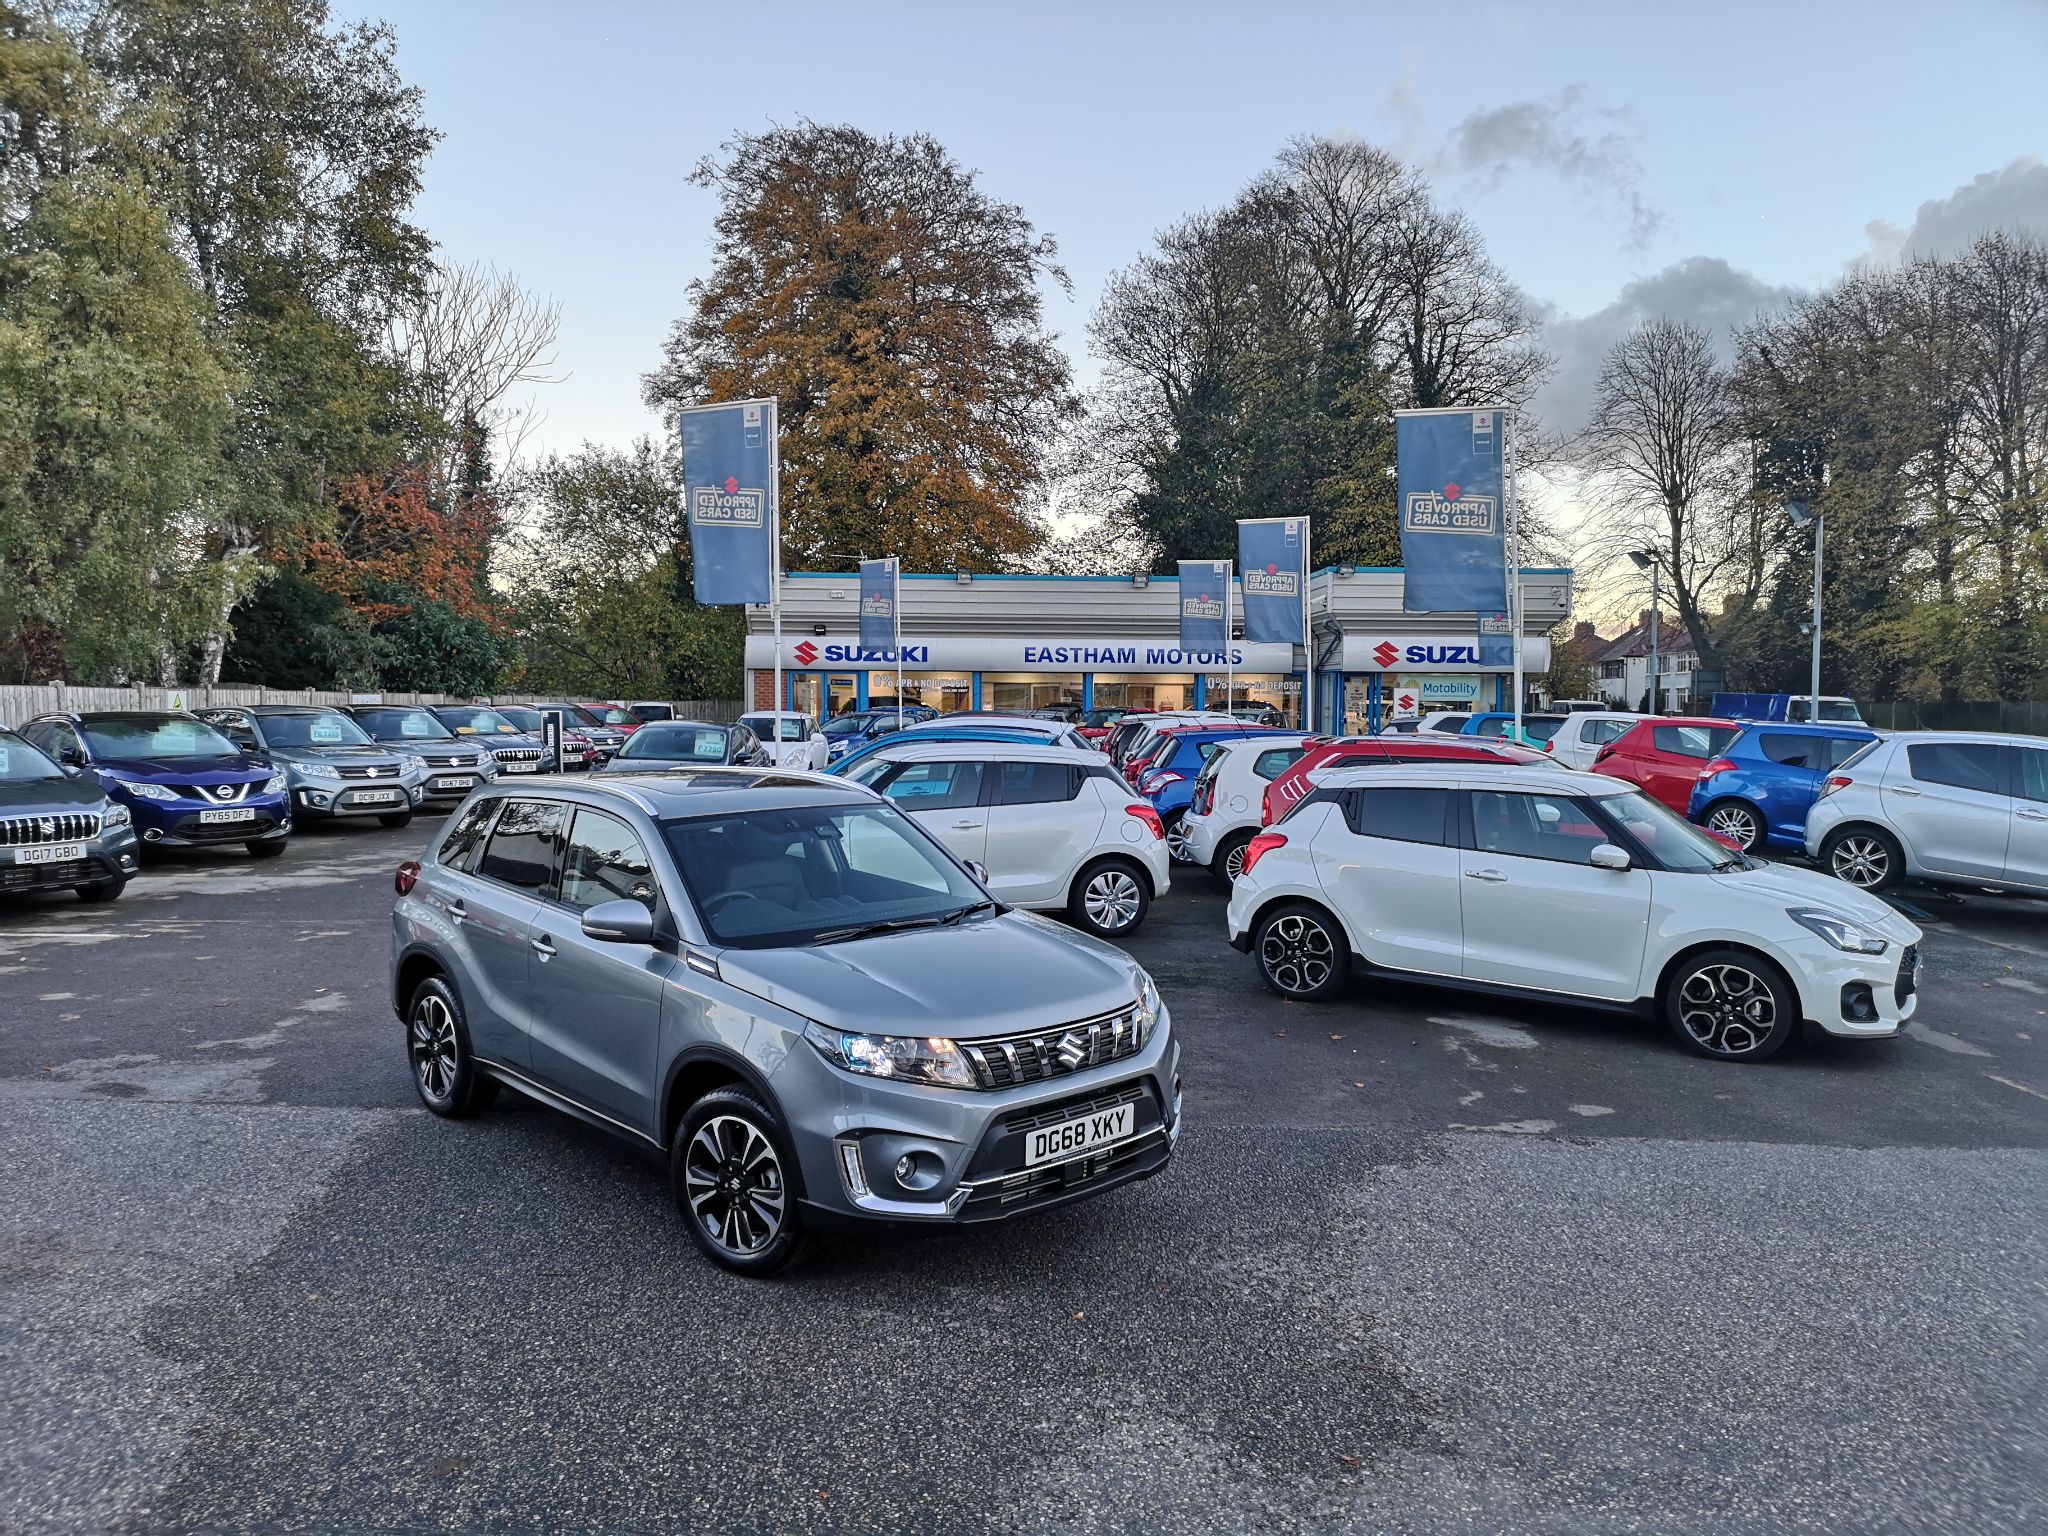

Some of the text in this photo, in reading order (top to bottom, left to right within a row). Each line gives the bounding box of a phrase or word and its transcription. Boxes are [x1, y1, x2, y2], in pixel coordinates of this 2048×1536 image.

[825, 645, 928, 663] SUZUKI
[1024, 647, 1243, 665] EASTHAM MOTORS
[920, 679, 932, 688] NO
[1207, 677, 1227, 690] 0%
[1268, 681, 1302, 690] DEPOSIT
[1423, 683, 1477, 696] Motability
[377, 792, 391, 800] JXX
[205, 809, 250, 821] PY65 DFZ
[24, 848, 51, 861] DG17
[1035, 1122, 1086, 1158] DG68
[1091, 1109, 1126, 1142] XKY
